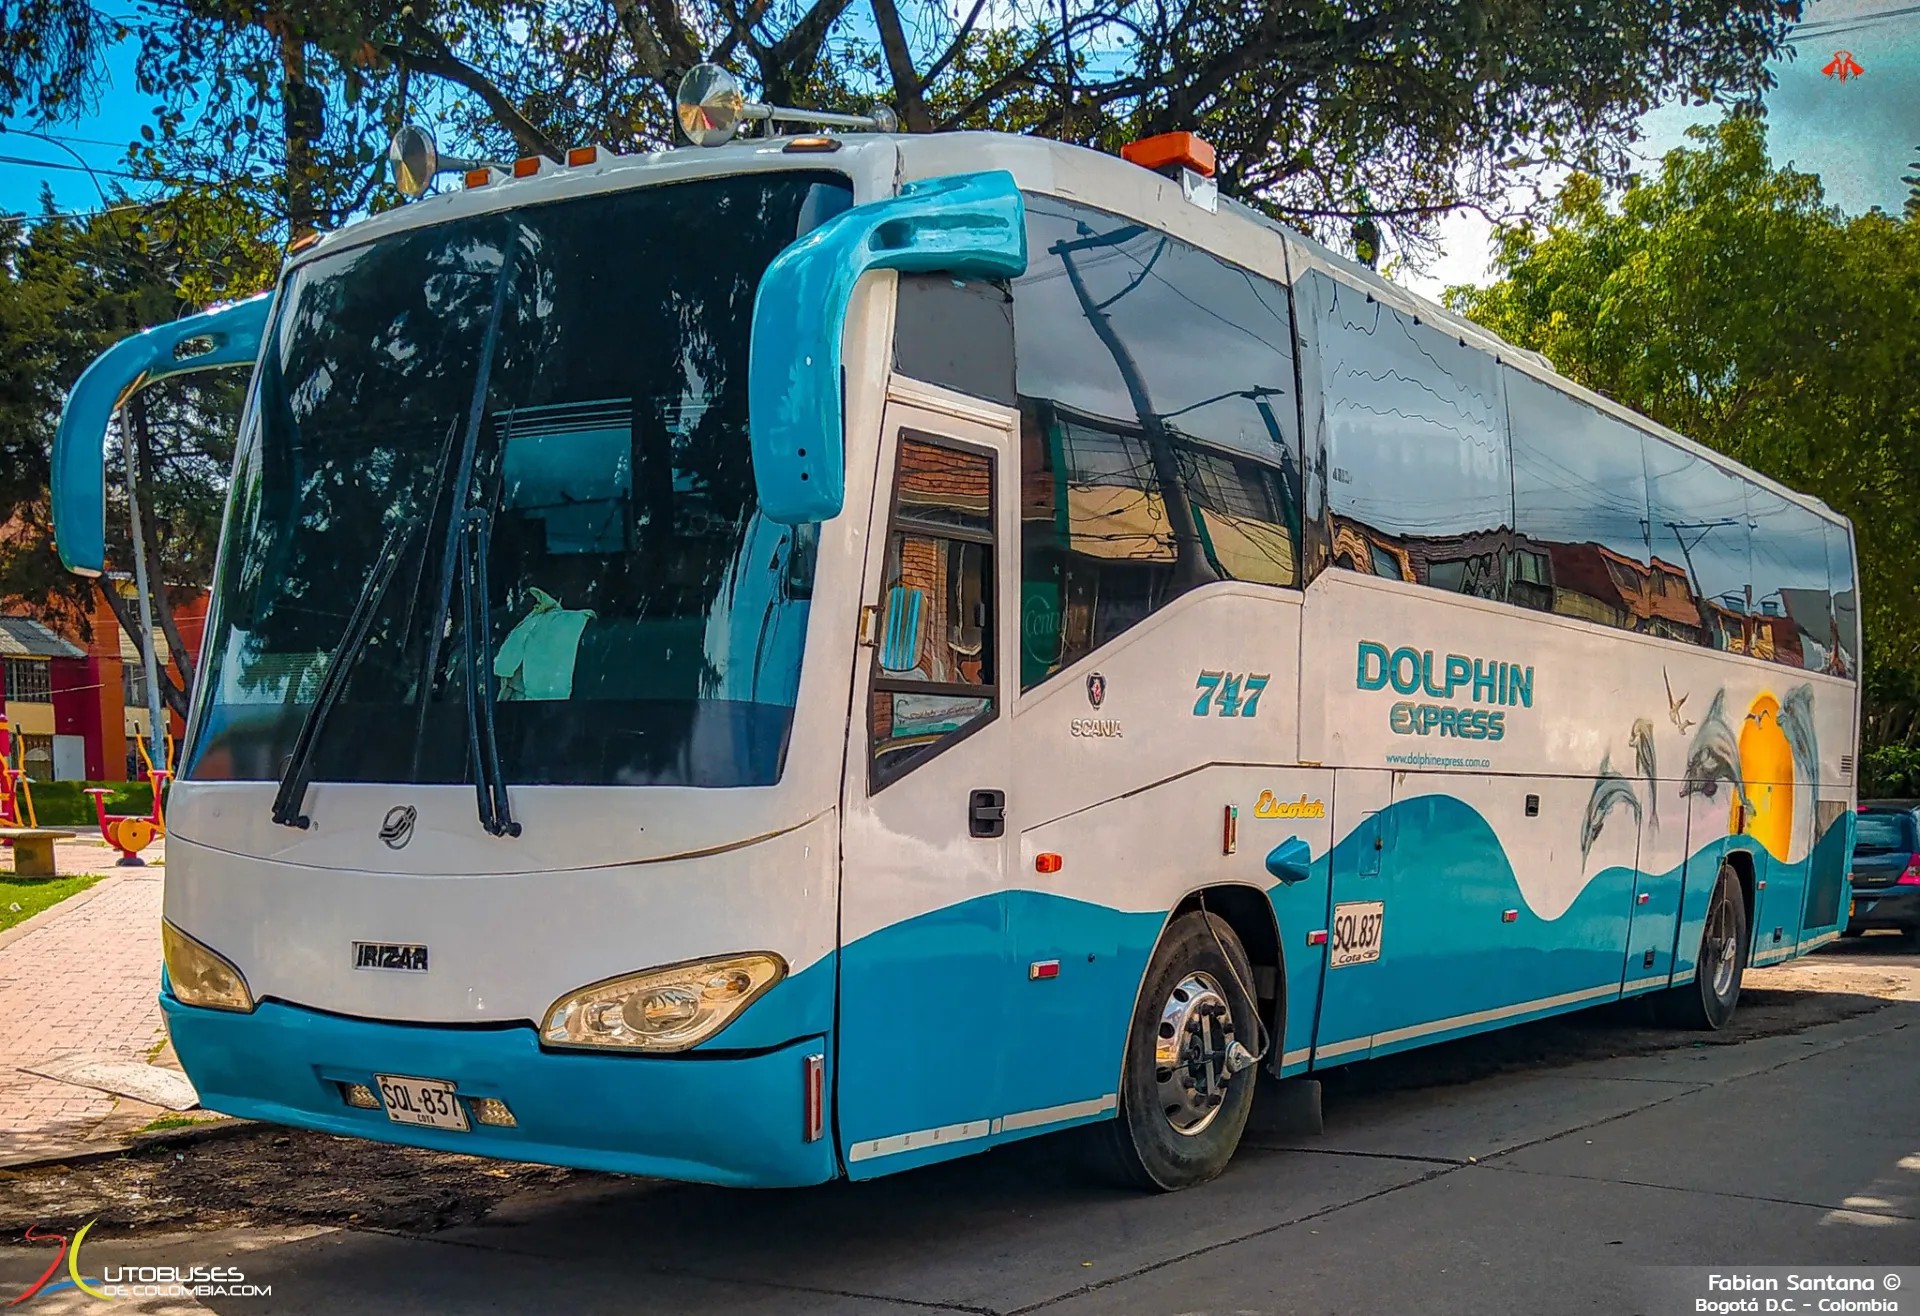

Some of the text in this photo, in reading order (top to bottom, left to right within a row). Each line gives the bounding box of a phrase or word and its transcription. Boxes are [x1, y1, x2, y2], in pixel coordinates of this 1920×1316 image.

[1357, 639, 1534, 708] DOLPHIN
[1193, 669, 1270, 717] 747
[1071, 719, 1123, 737] SCANIA
[1390, 701, 1505, 741] EXPRESS
[1386, 753, 1490, 768] www.dolphinexpress.com.co
[1254, 789, 1325, 818] Escolar
[357, 944, 428, 970] IRIZAR
[1339, 954, 1361, 964] Cota
[417, 1114, 435, 1124] COTA
